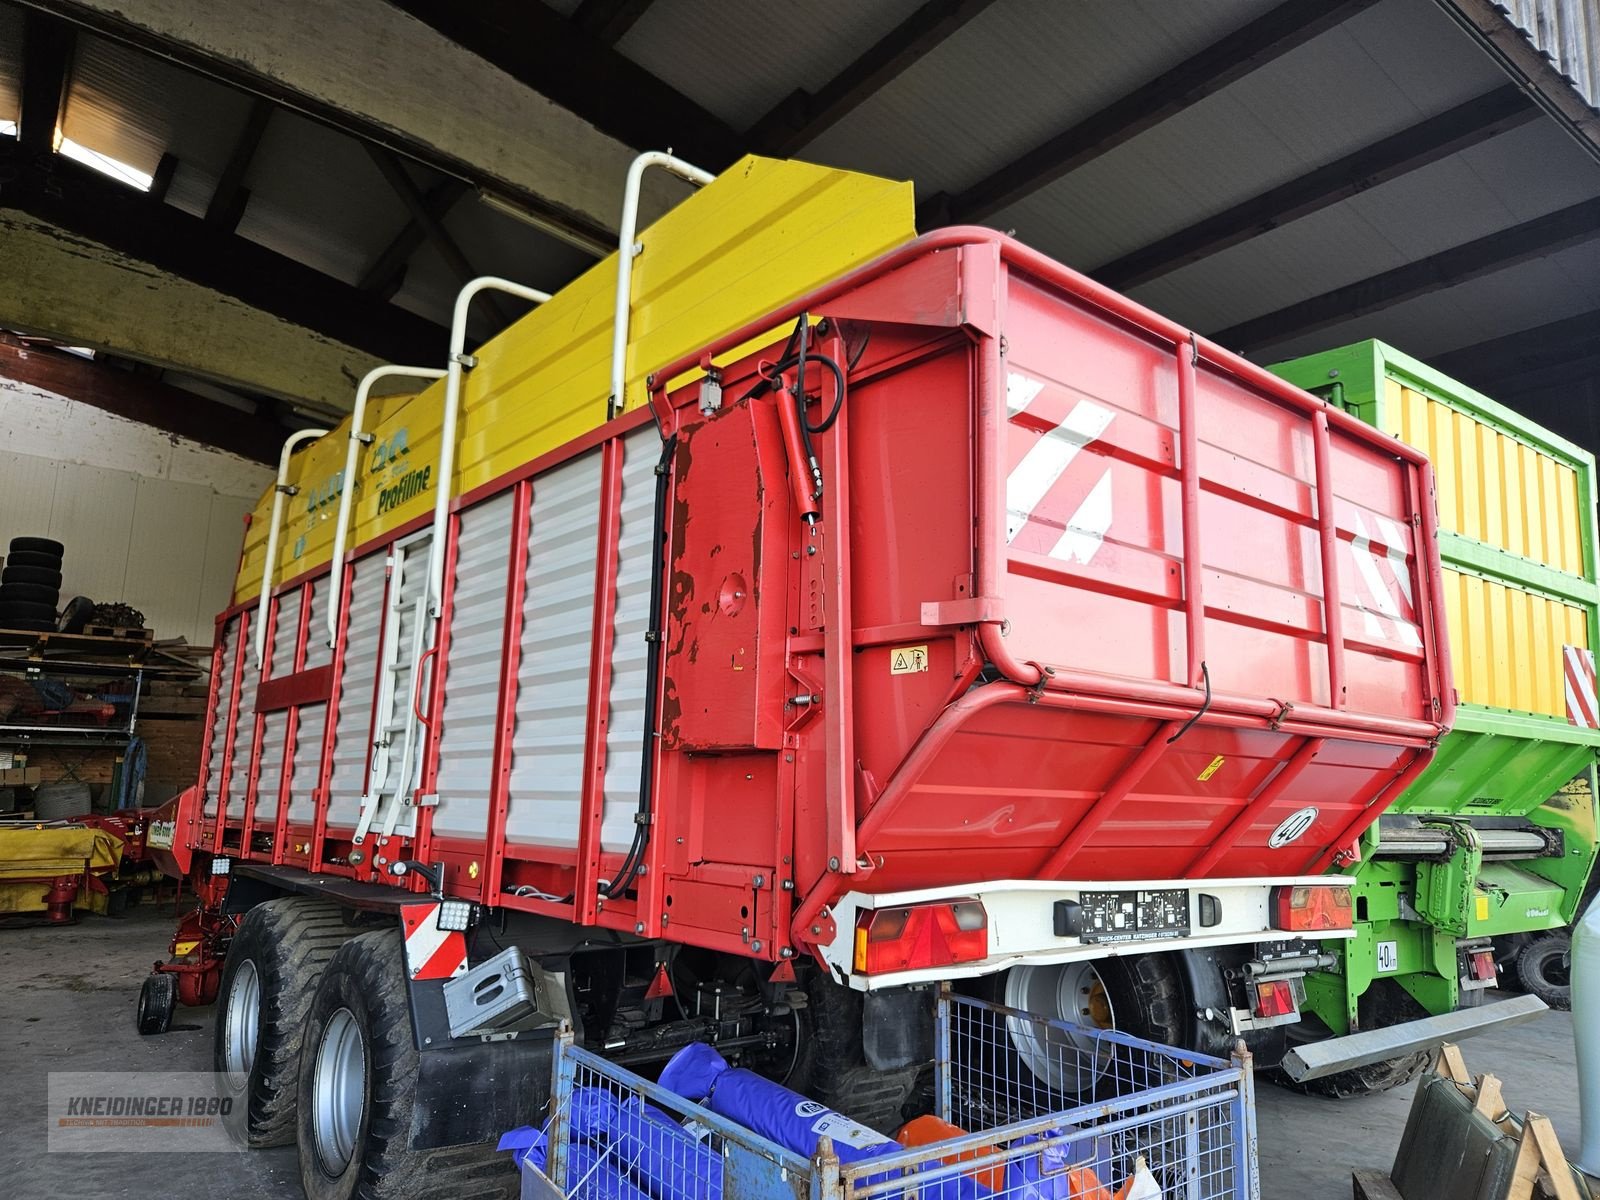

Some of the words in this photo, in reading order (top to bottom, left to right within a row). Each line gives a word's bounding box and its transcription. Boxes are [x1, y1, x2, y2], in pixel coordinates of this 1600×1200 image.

[377, 465, 432, 516] Profiline
[1277, 814, 1312, 841] 40
[1379, 945, 1390, 969] 40
